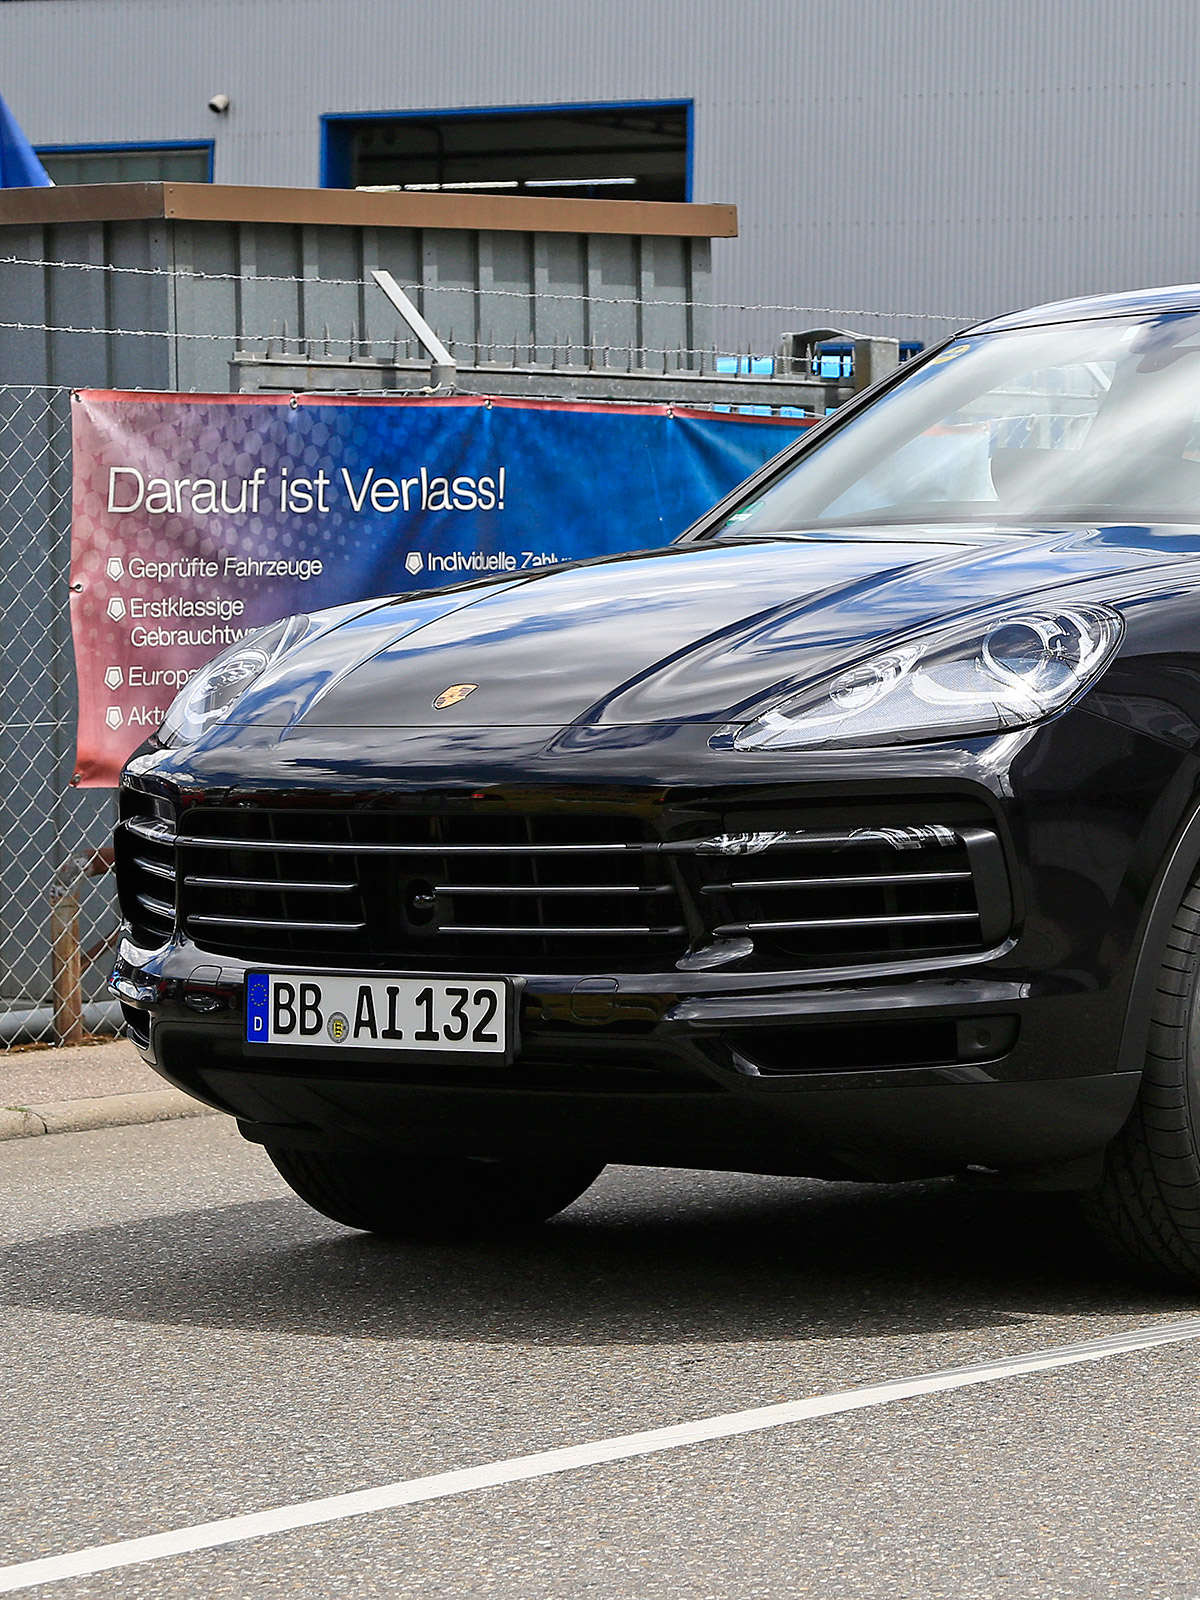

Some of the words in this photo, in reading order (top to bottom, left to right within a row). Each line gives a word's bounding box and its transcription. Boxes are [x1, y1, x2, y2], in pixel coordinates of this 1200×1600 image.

[106, 467, 266, 514] Darauf
[281, 467, 330, 513] ist
[341, 466, 506, 513] Verlass!
[128, 557, 218, 582] Geprüfte
[224, 557, 323, 580] Fahrzeuge
[427, 551, 516, 571] Individuelle
[130, 597, 245, 620] Erstklassige
[254, 1016, 262, 1031] D
[273, 982, 323, 1035] BB
[353, 985, 403, 1039] AI
[414, 987, 498, 1042] 132
